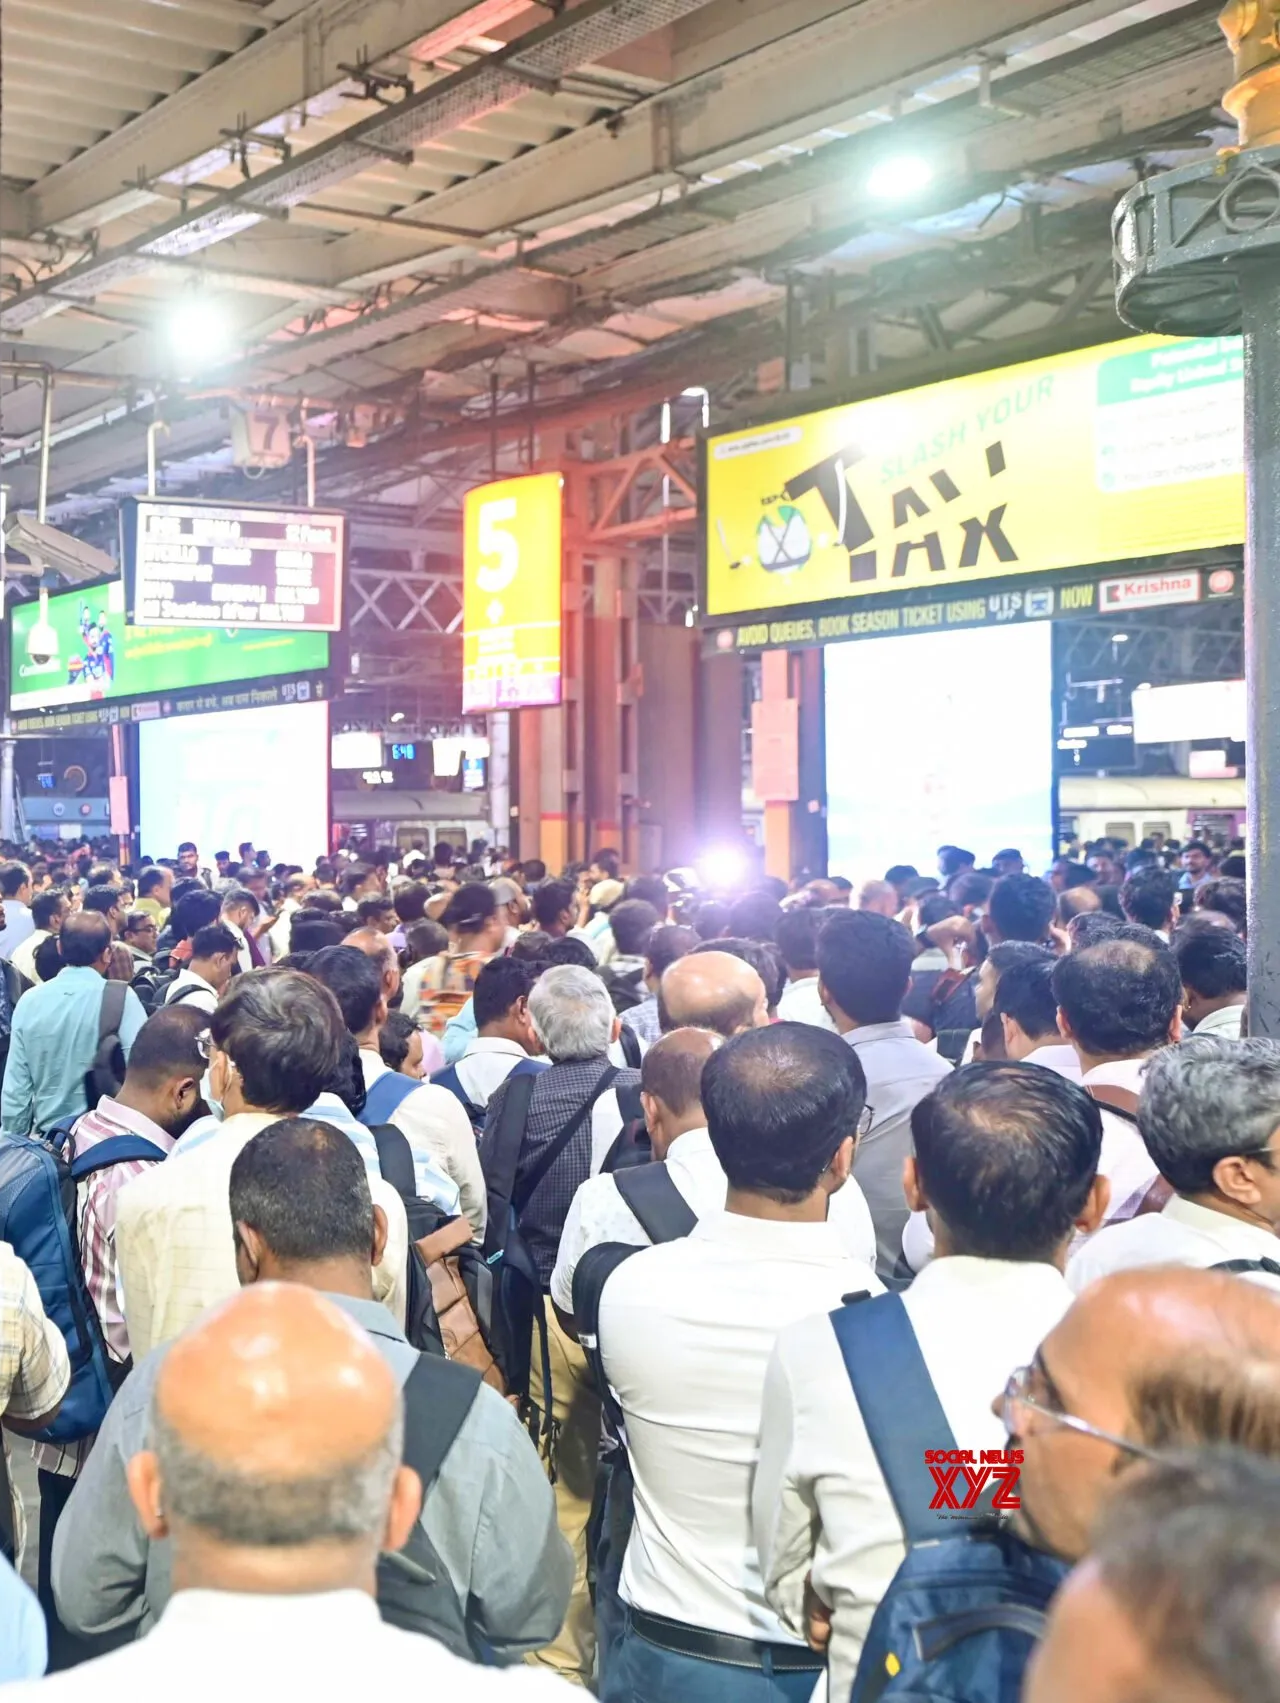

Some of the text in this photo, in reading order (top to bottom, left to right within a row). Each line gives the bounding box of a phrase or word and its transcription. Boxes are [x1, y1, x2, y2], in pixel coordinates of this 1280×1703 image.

[255, 413, 279, 449] 7
[880, 375, 1055, 484] SLASH YOUR
[476, 496, 519, 593] 5
[736, 584, 1094, 646] AVOID QUEUES, BOOK SEASON TICKET USING UTS NOW
[1124, 574, 1192, 597] Krishna
